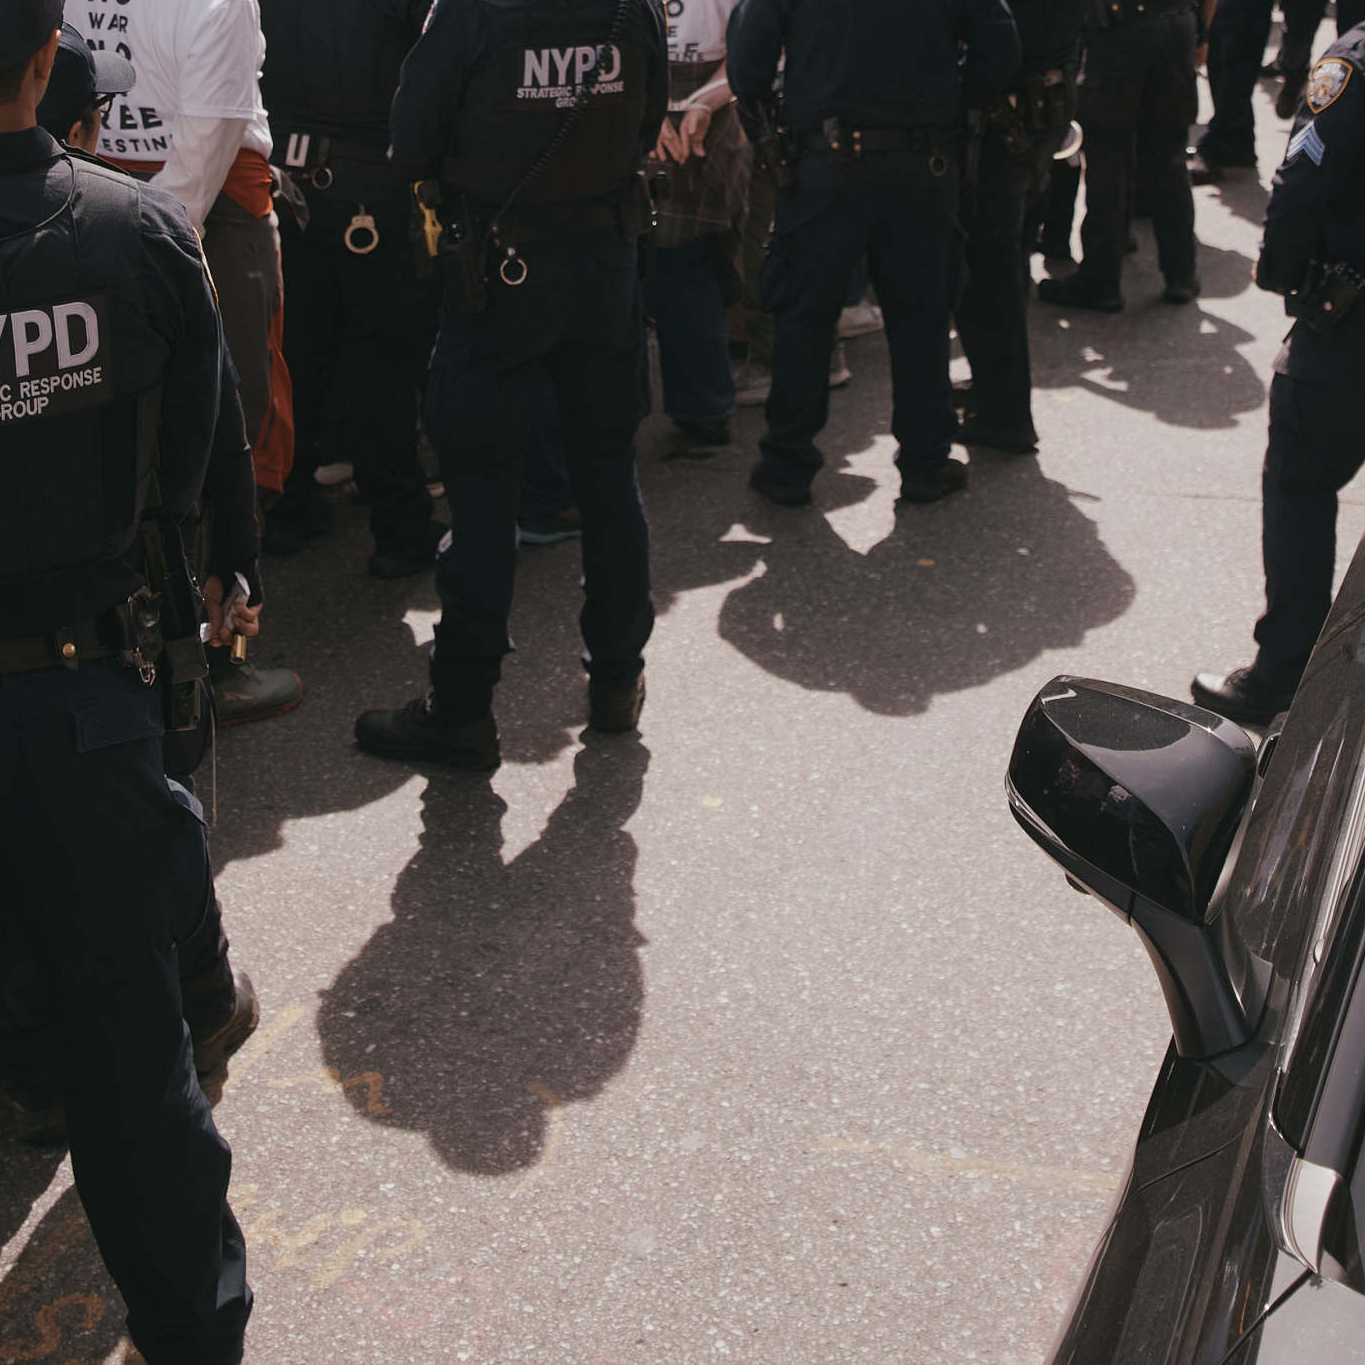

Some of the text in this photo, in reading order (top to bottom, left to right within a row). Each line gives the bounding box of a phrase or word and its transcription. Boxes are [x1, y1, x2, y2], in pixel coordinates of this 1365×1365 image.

[88, 12, 129, 33] WAR
[523, 44, 621, 87] NYPD
[516, 86, 572, 99] STRATEGIC
[19, 366, 102, 399] RESPONSE
